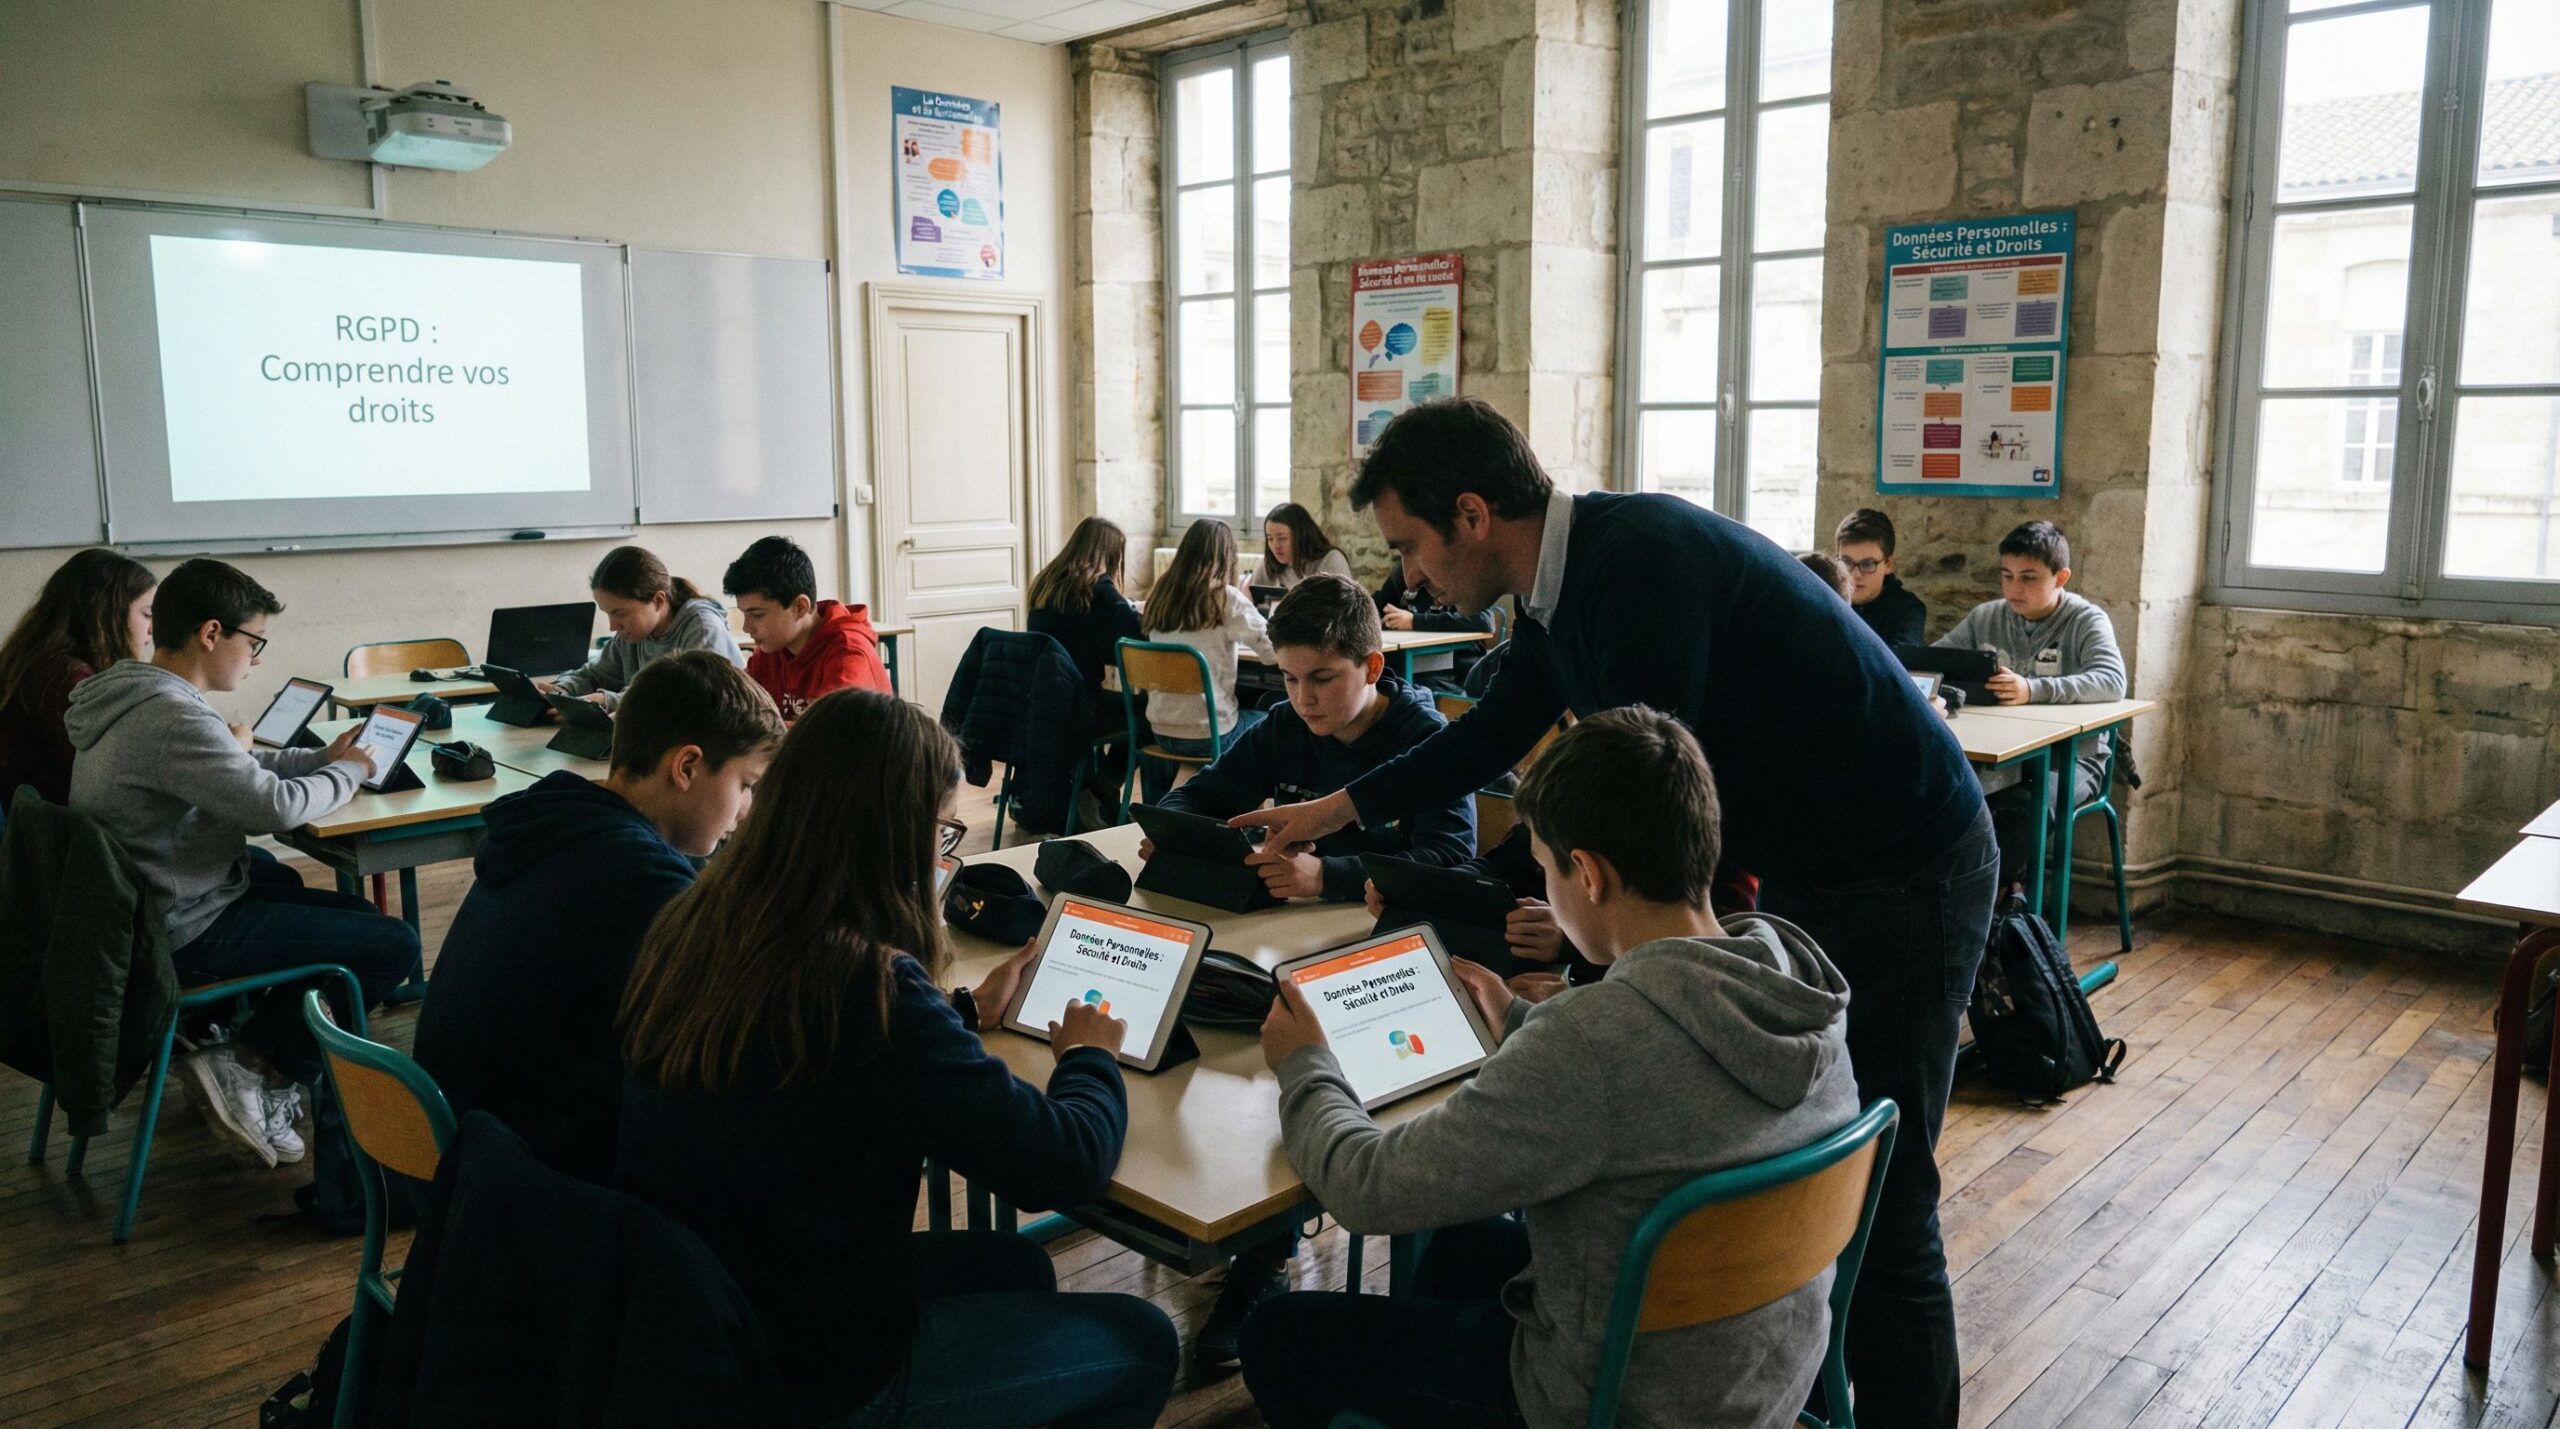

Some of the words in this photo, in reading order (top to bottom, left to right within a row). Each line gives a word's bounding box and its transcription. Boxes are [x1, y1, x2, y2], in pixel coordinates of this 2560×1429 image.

[1893, 228, 1954, 247] Données
[1957, 220, 2058, 241] Personnelles
[1911, 240, 1973, 260] Sécurité
[1976, 242, 1992, 255] et
[1995, 238, 2043, 254] Droits
[336, 314, 420, 344] RGPD
[260, 354, 454, 388] Comprendre
[463, 363, 510, 386] vos
[348, 395, 435, 424] droits
